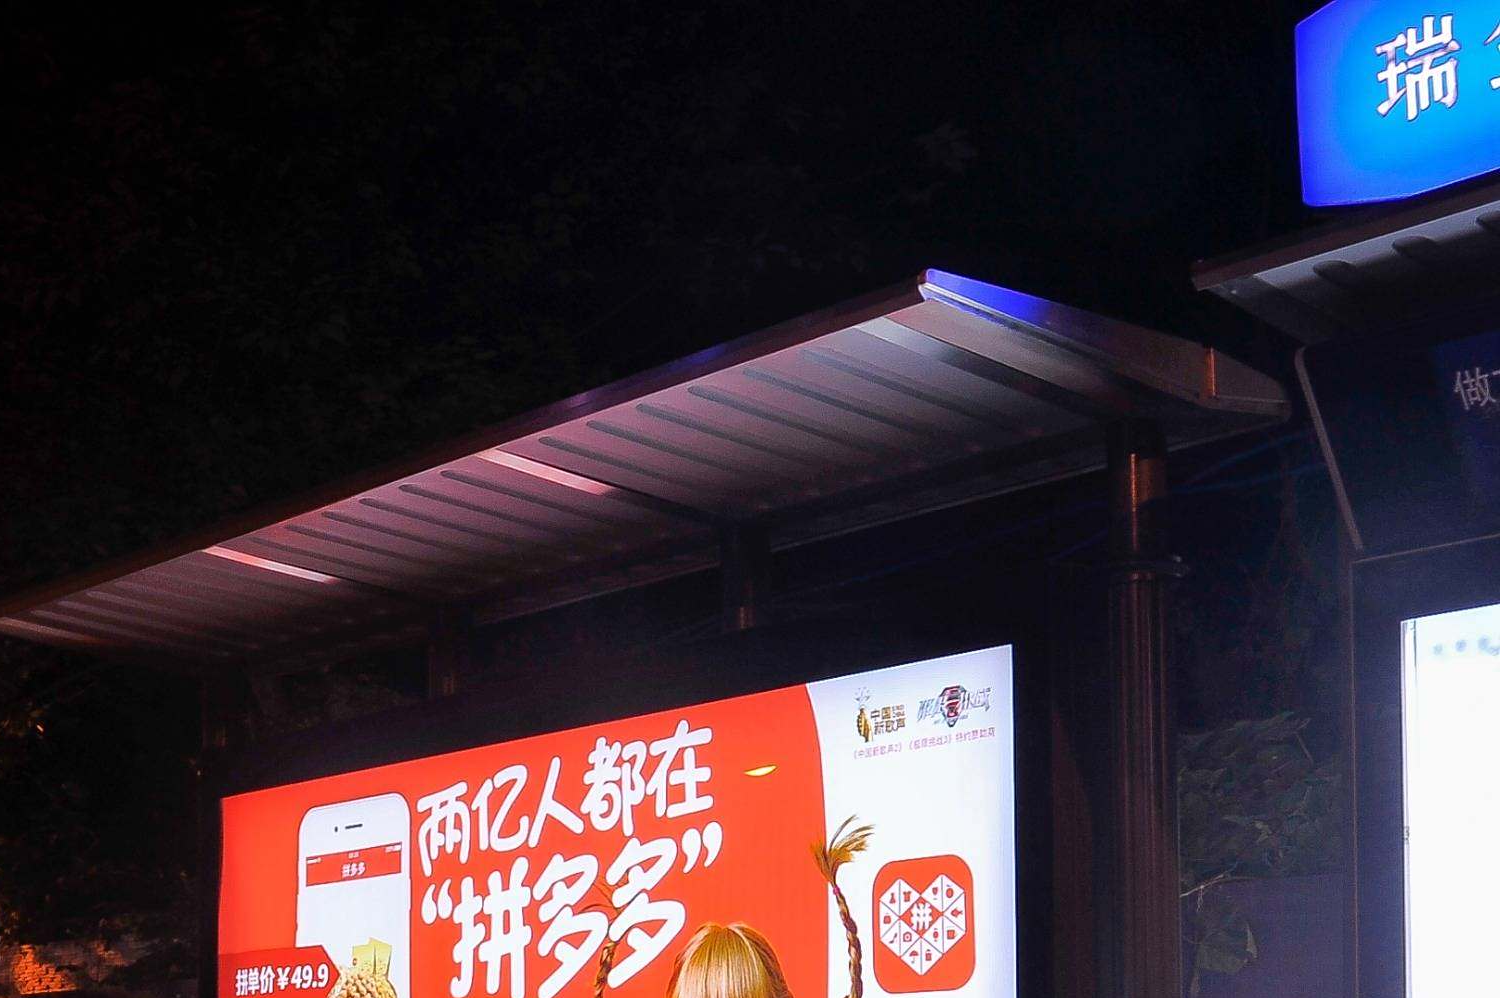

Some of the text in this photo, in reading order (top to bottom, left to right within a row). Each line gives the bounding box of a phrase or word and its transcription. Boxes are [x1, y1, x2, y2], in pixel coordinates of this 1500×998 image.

[1375, 14, 1500, 122] 瑞
[1453, 367, 1500, 411] 做
[417, 719, 714, 877] 两亿人都在
